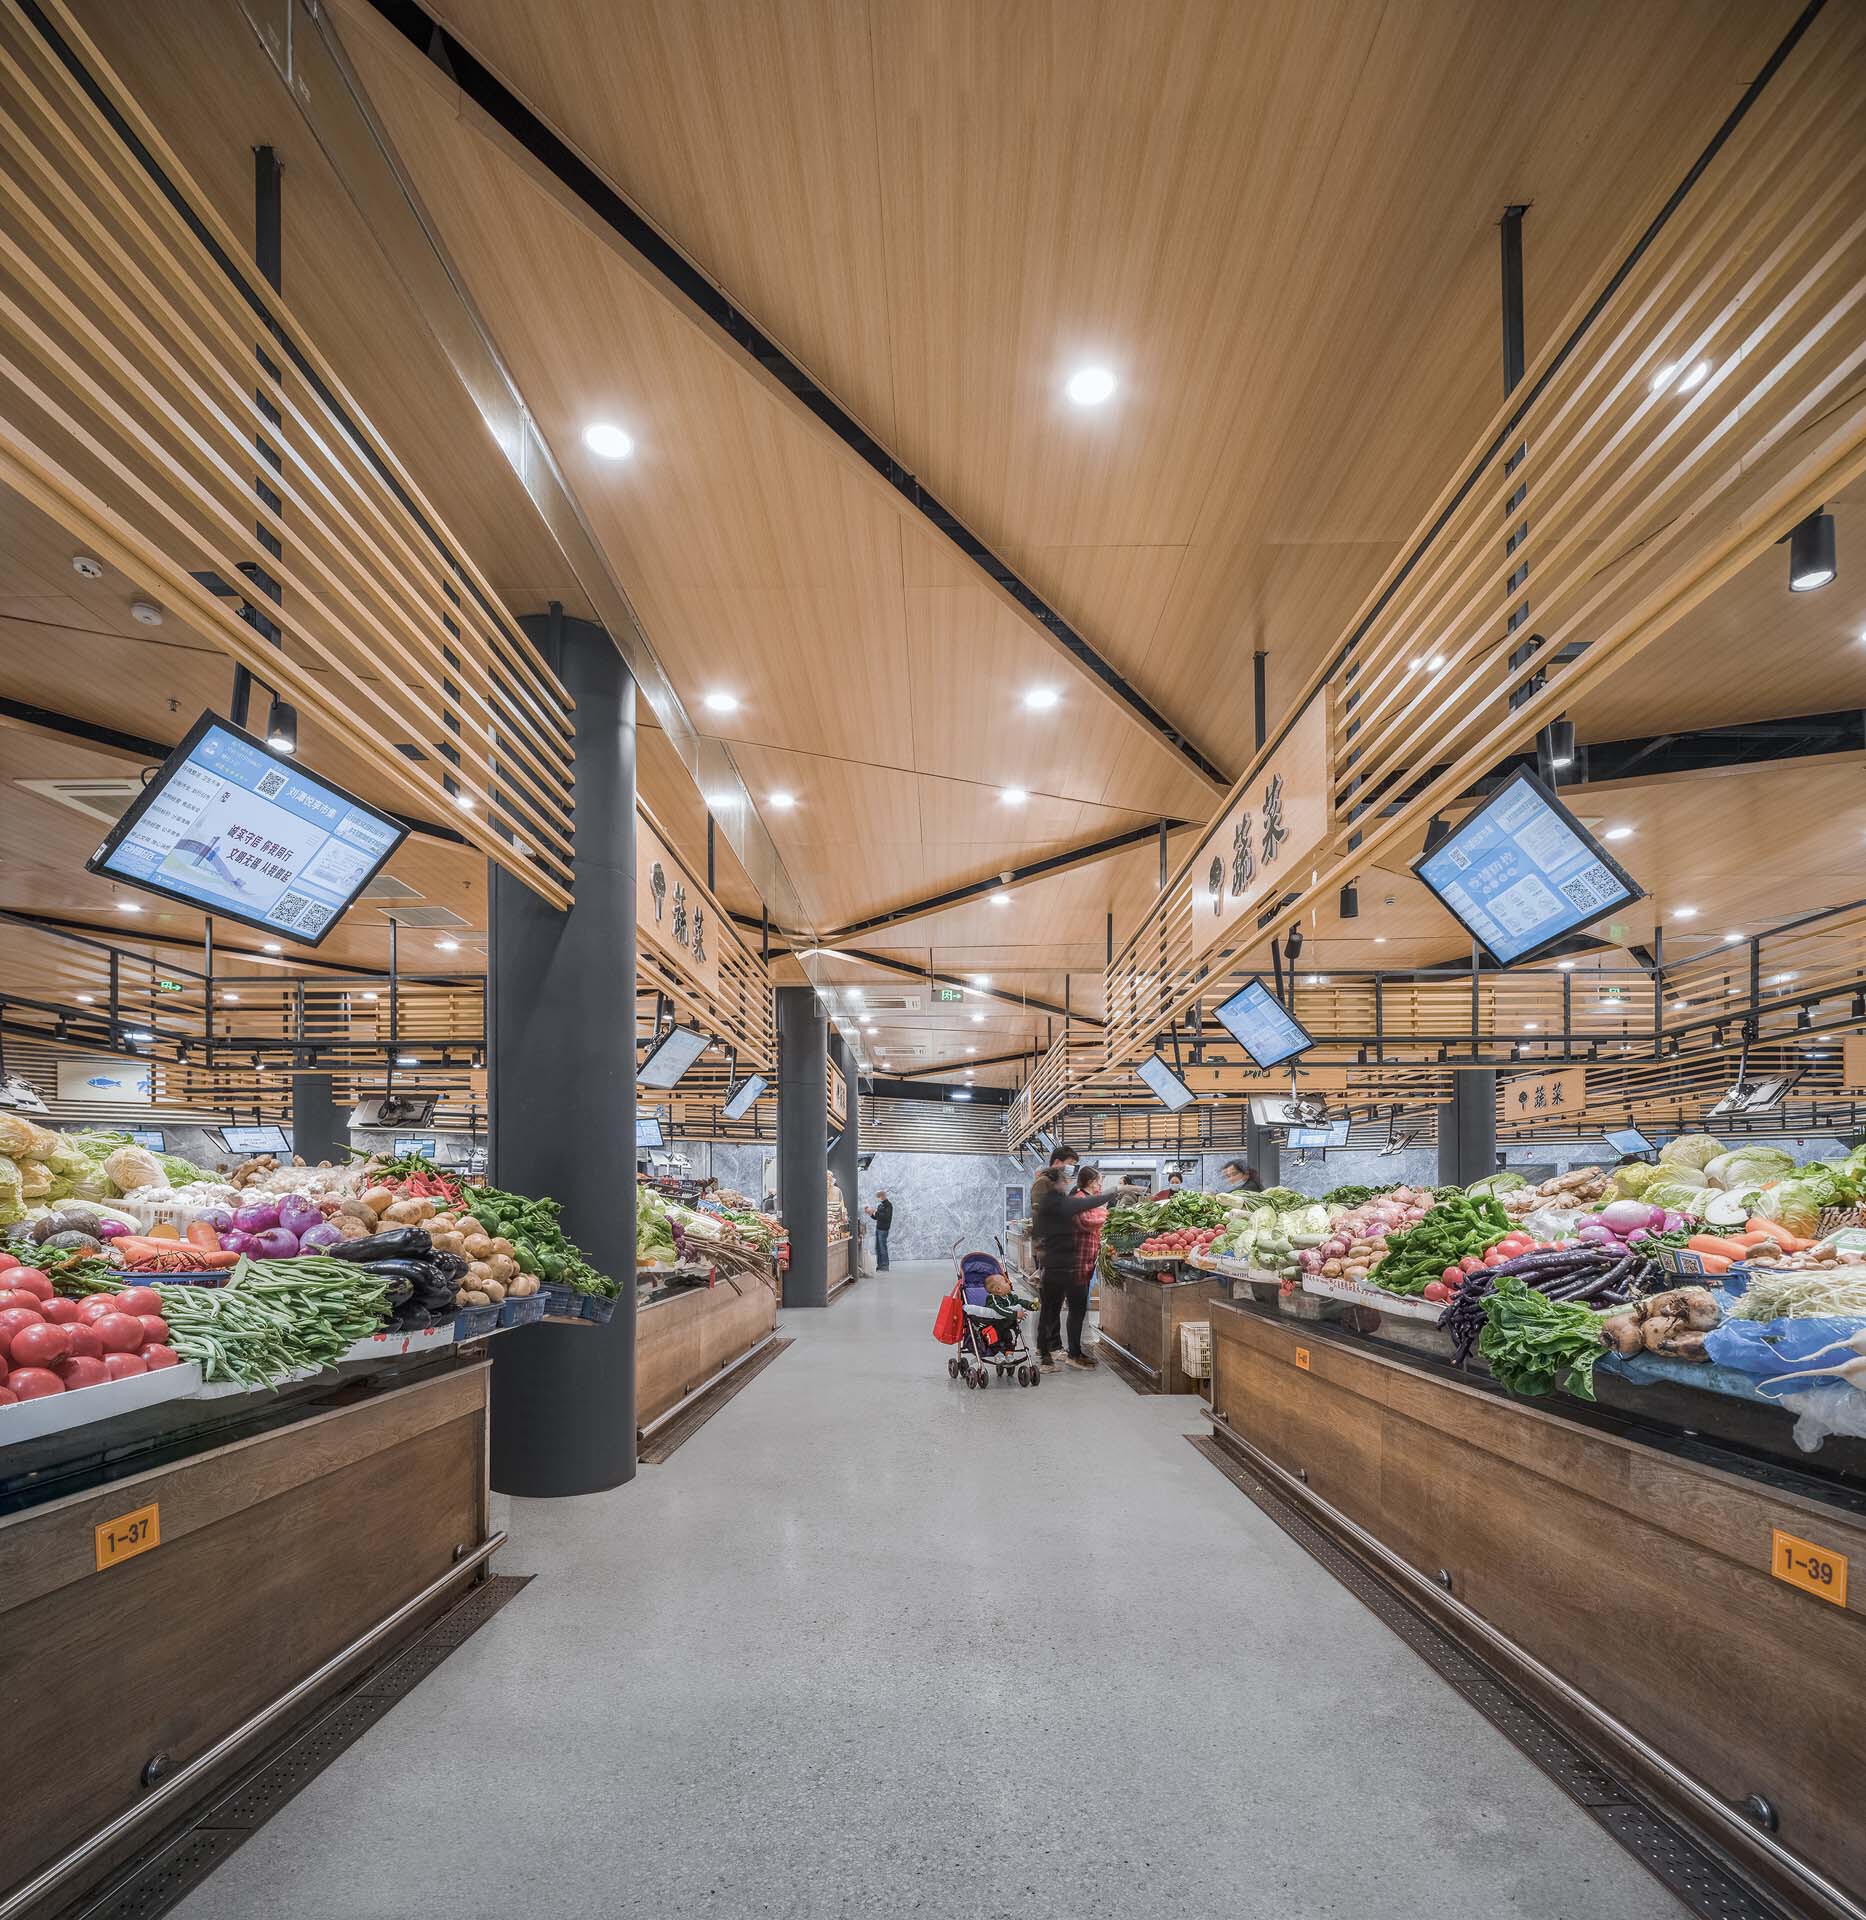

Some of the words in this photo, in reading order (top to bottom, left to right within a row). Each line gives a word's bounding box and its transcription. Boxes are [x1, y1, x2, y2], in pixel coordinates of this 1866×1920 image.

[227, 824, 263, 848] 诚实守信
[260, 840, 294, 862] 你我同行
[1232, 773, 1289, 897] 蔬菜
[226, 848, 262, 870] 文明无锡
[260, 861, 293, 883] 从我做起
[671, 880, 707, 964] 蔬菜
[1534, 1081, 1564, 1109] 蔬菜
[107, 1518, 149, 1553] 1-37
[1784, 1548, 1833, 1585] 1-39
